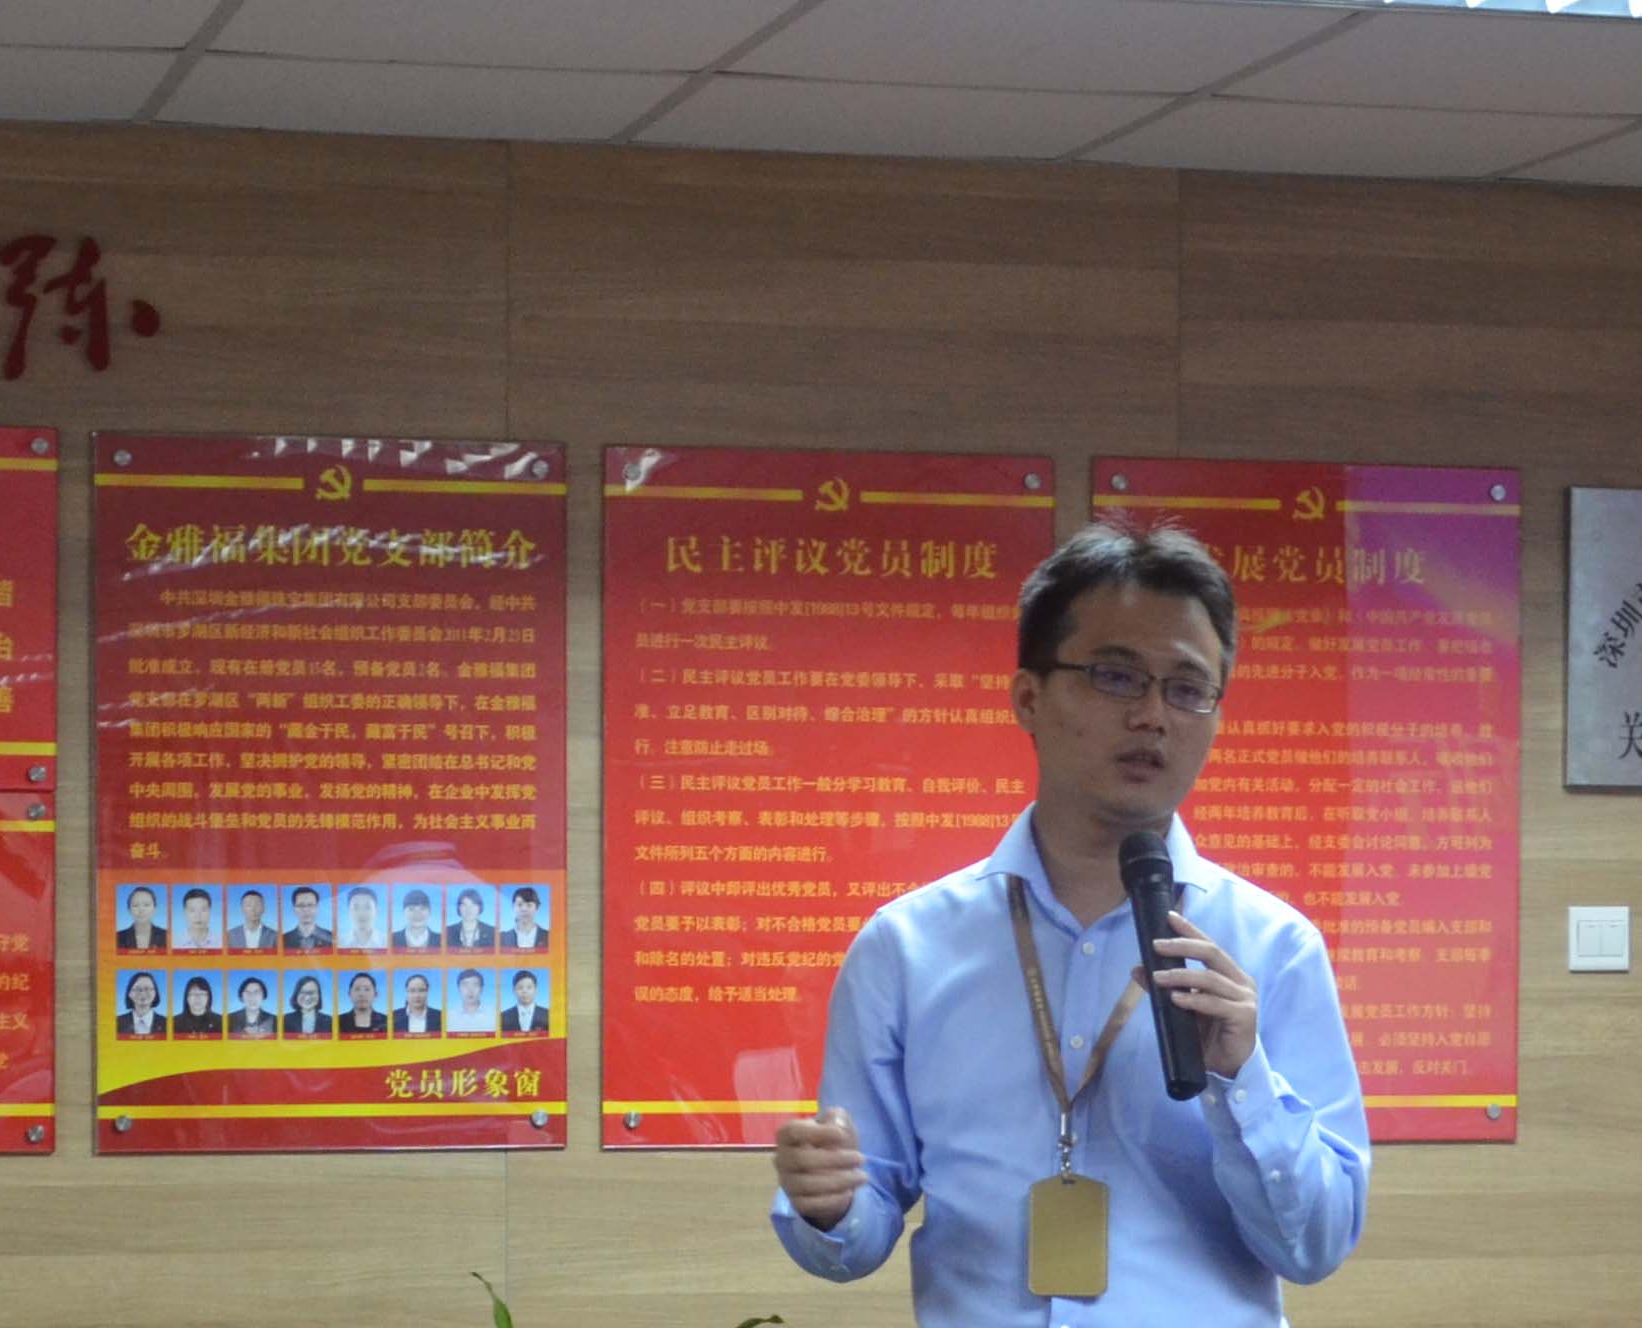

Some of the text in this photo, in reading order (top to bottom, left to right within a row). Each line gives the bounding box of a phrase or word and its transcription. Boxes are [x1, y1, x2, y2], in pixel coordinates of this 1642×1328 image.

[124, 523, 536, 571] 金雅福集团党支部简介
[665, 535, 998, 580] 民主评议党员制度
[385, 1068, 542, 1098] 党员形象窗
